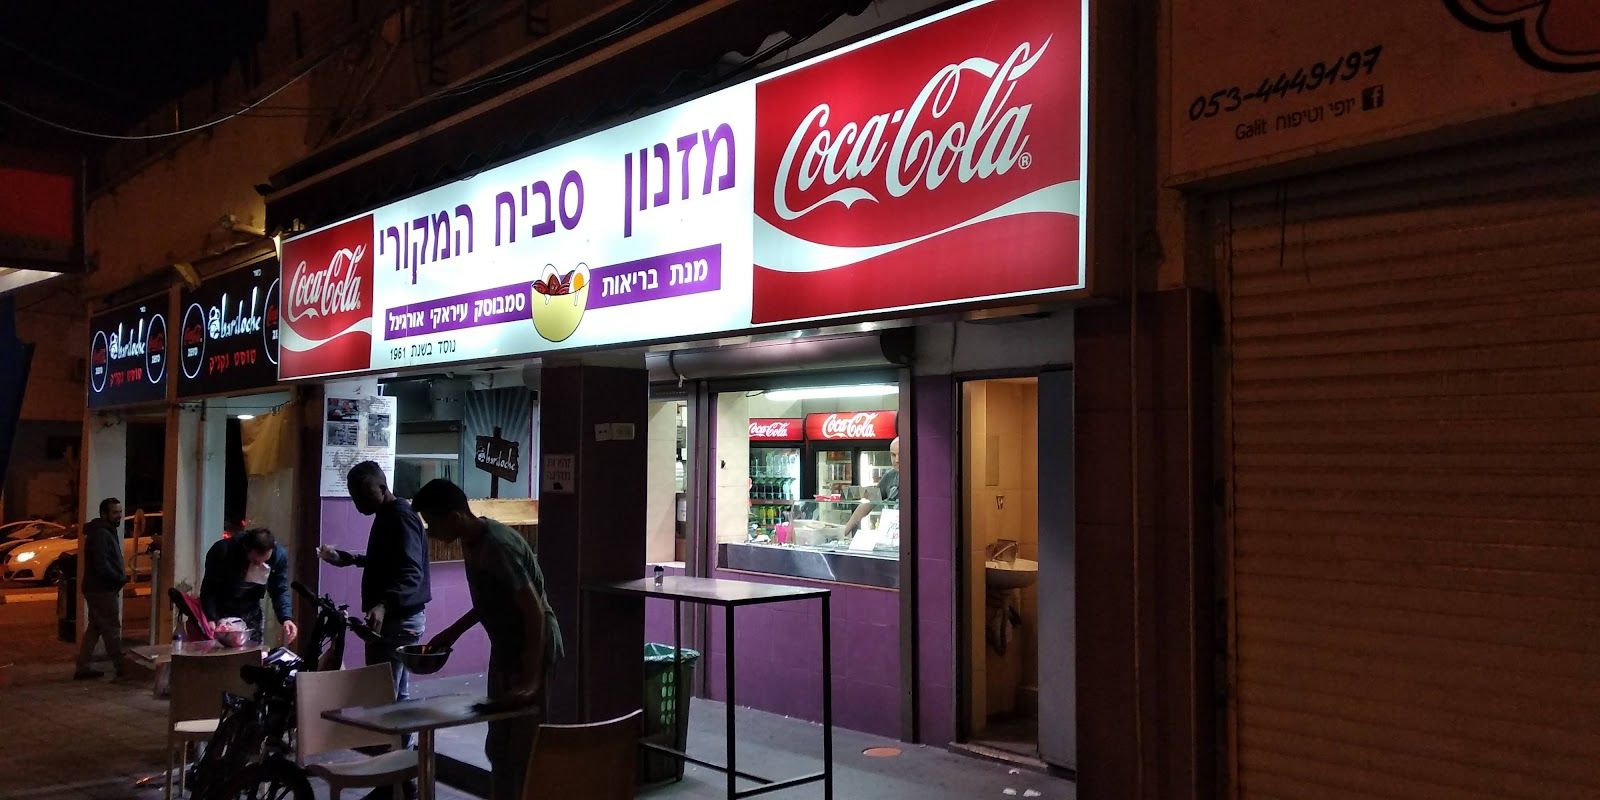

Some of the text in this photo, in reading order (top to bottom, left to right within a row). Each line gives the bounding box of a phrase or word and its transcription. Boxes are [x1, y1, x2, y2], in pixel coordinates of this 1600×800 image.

[1188, 45, 1383, 121] 053-4449197
[1276, 106, 1324, 131] וטיפוח
[1329, 98, 1355, 117] יופי
[773, 33, 1053, 220] Coca-Cola
[1235, 118, 1267, 140] Galit
[380, 122, 735, 284] מזנון סביח המקורי
[287, 243, 367, 322] Coca-Cola
[601, 258, 708, 297] מנת בריאות
[389, 292, 525, 331] סמבוסק עיראקי אורגינל
[410, 342, 432, 357] בשנת
[438, 339, 456, 353] נוסד
[822, 412, 879, 438] Coca-Cola
